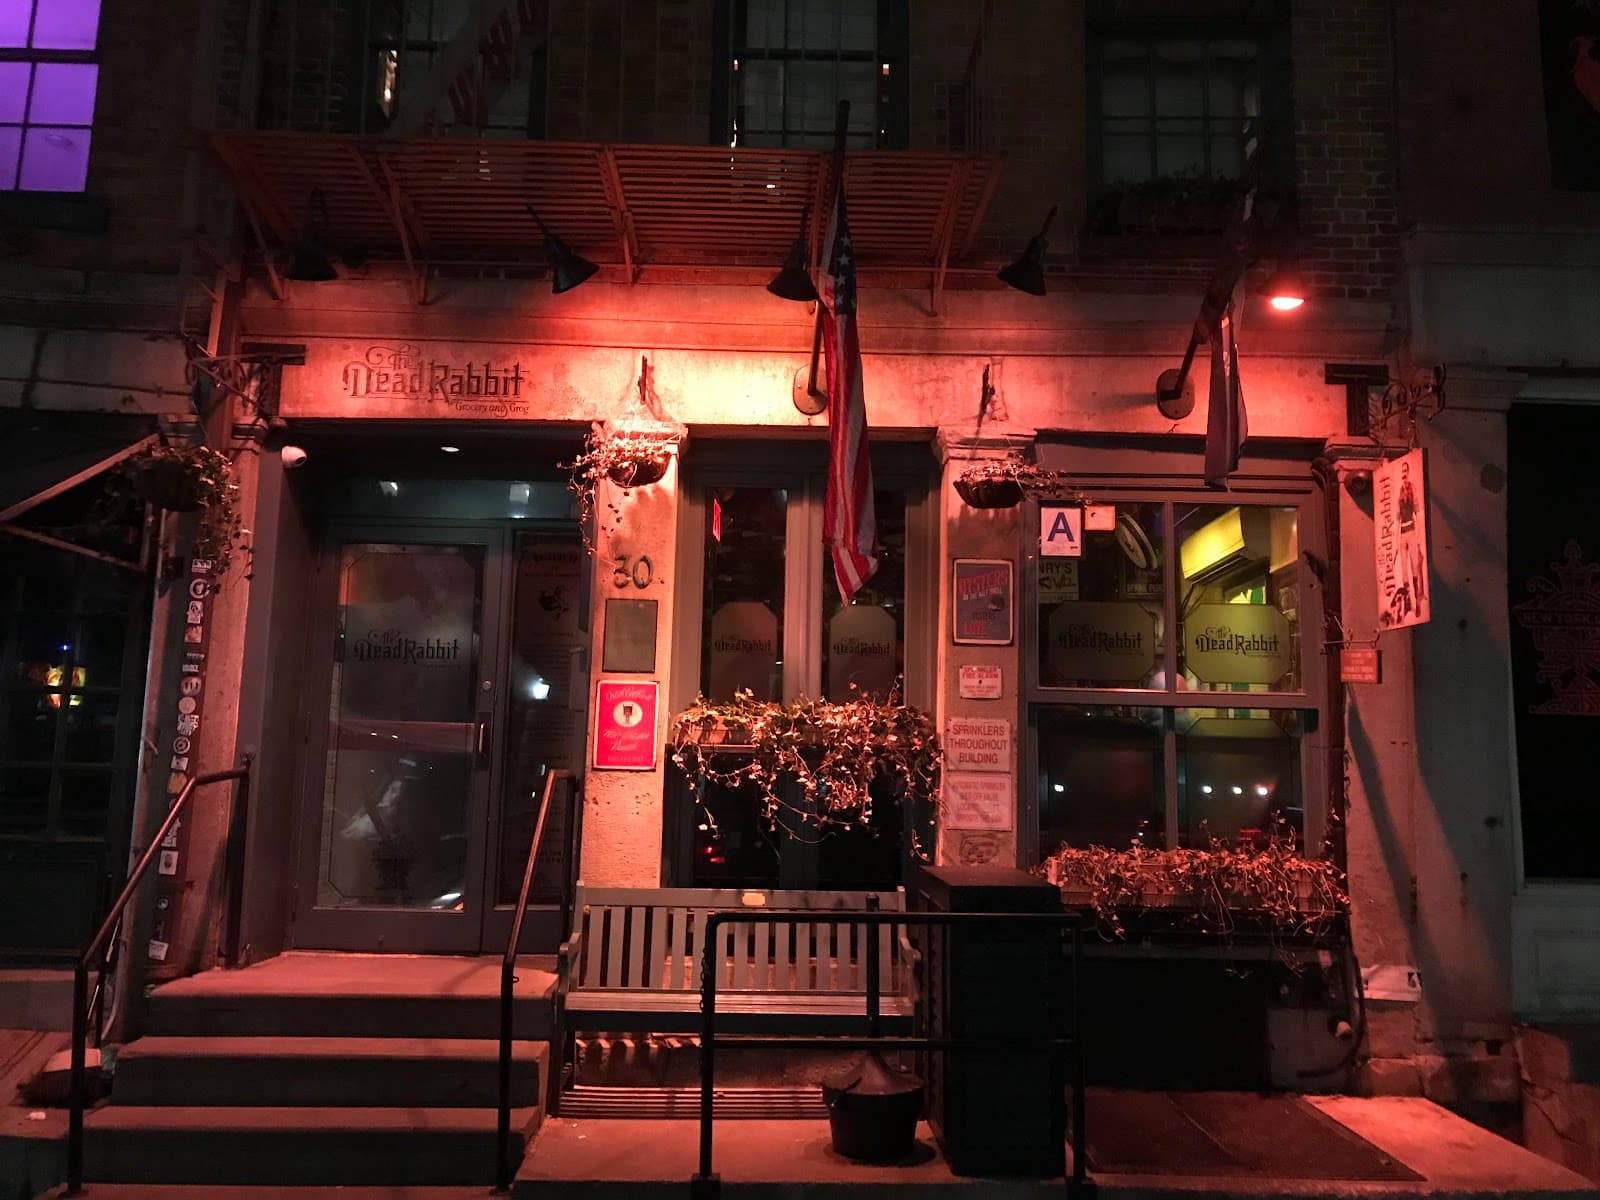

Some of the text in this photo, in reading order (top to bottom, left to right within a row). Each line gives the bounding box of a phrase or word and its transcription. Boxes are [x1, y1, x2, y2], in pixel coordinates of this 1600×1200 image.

[342, 360, 524, 404] Dead Rabbit
[456, 400, 530, 417] Grocery and Grog
[1379, 477, 1394, 540] Rabbit
[1047, 511, 1074, 541] A
[613, 555, 652, 588] 30
[402, 638, 460, 664] Rabbit
[1098, 631, 1142, 652] Rabbit
[1195, 634, 1280, 655] Dead Rabbit
[953, 725, 1004, 736] SPRINKLERS
[950, 738, 1008, 750] THROUGHOUT
[959, 753, 998, 764] BUILDING
